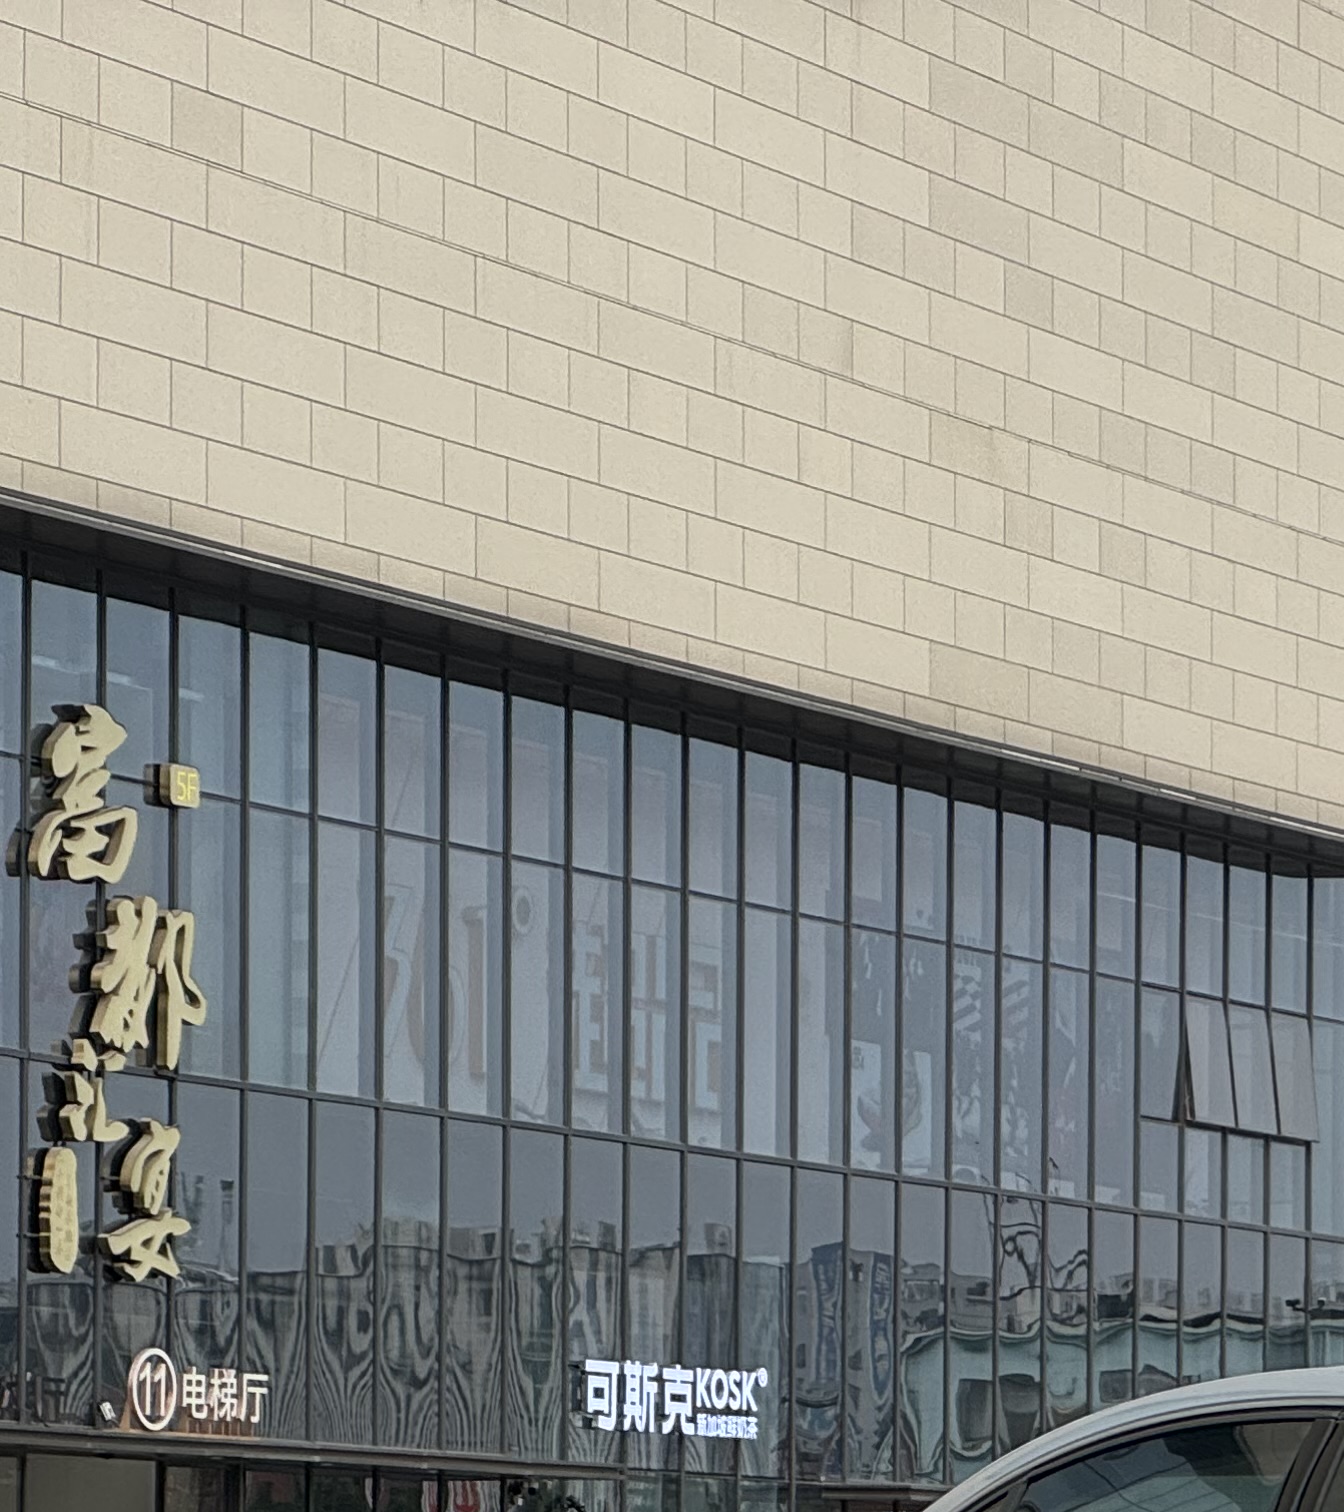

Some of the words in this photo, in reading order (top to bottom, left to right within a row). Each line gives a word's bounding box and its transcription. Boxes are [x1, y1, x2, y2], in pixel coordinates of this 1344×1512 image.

[177, 771, 197, 801] 5F
[138, 1361, 168, 1418] 11
[181, 1365, 269, 1424] 电梯厅
[584, 1358, 695, 1436] 可斯克
